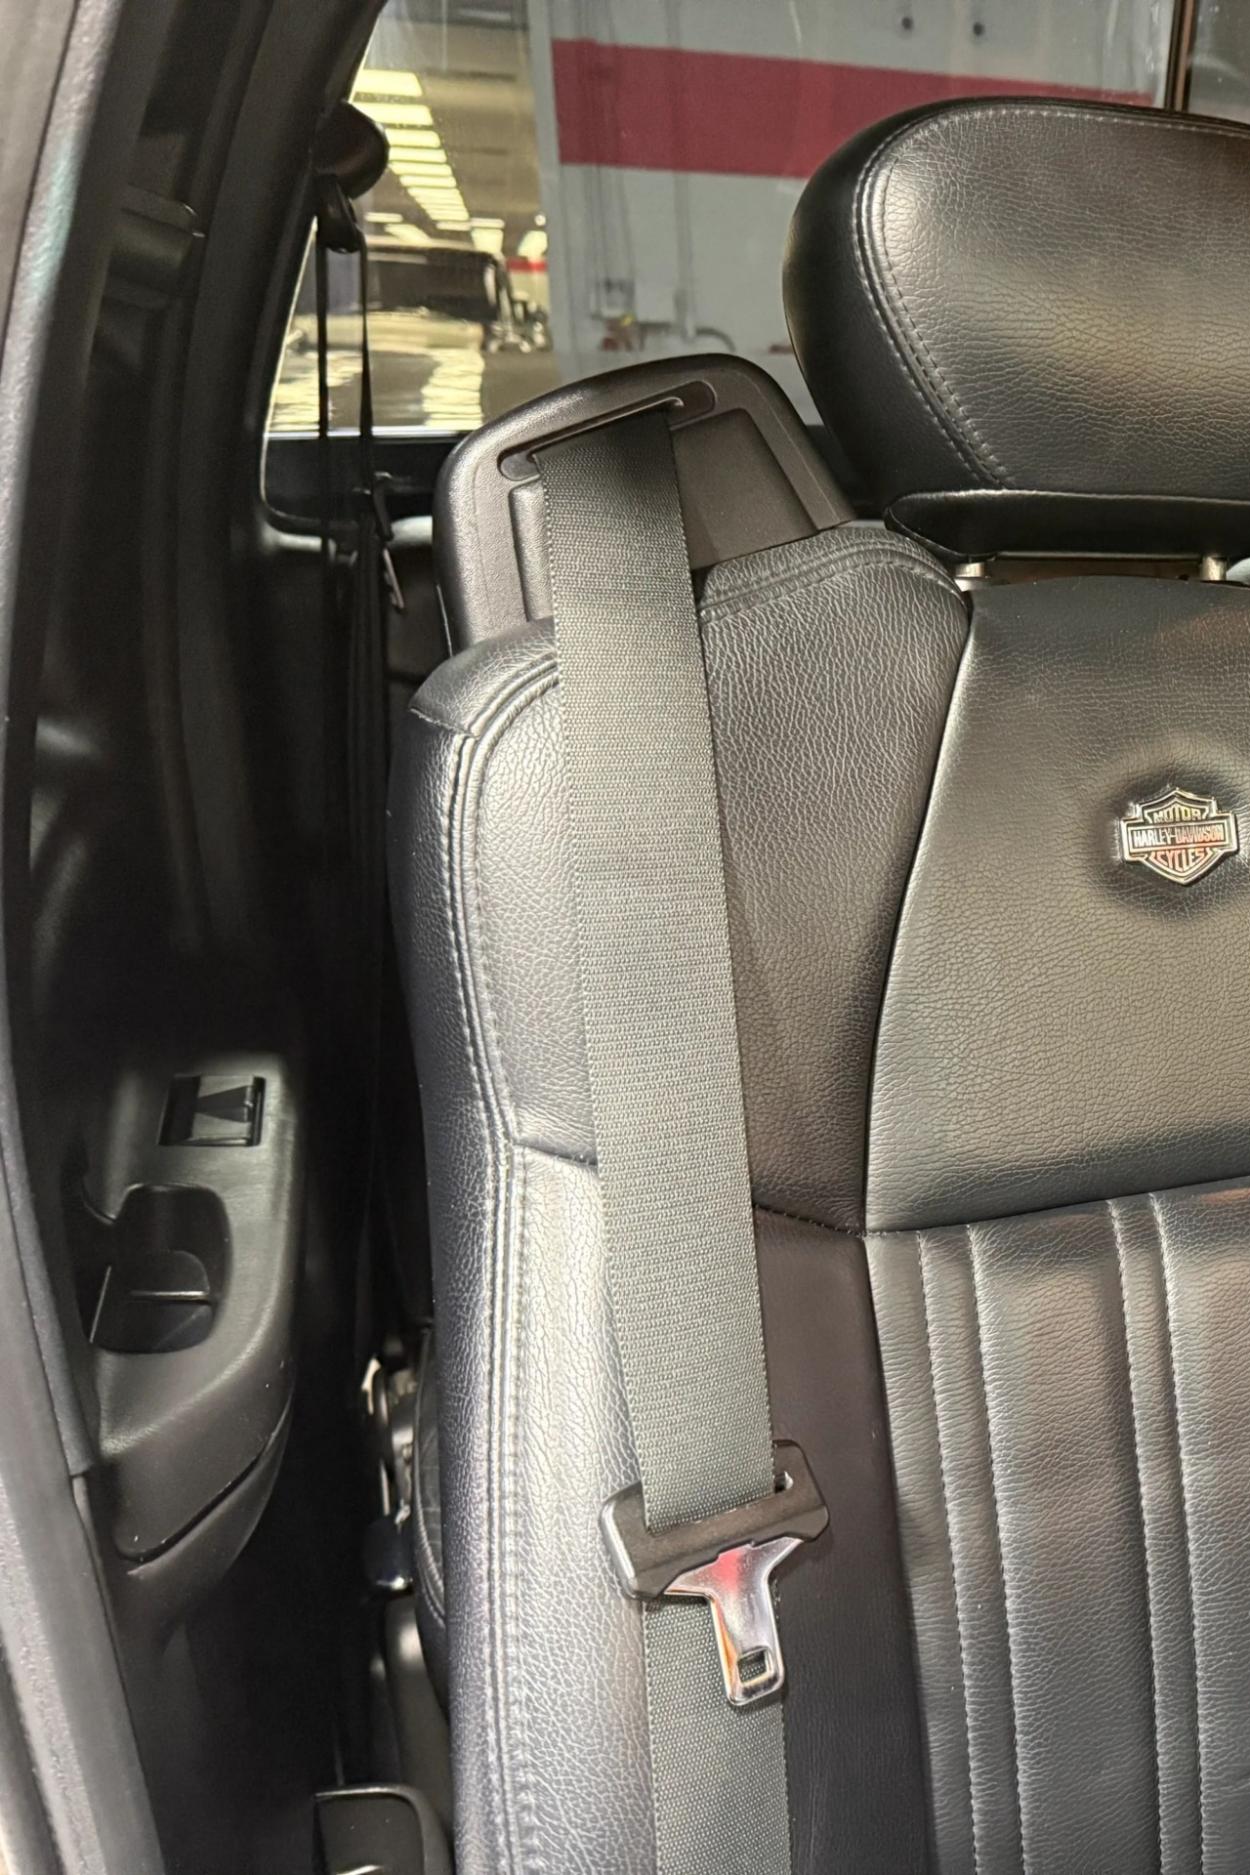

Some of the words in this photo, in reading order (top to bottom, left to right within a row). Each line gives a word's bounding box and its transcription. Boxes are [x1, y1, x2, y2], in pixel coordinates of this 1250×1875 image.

[1153, 803, 1201, 823] MOTOR
[1132, 824, 1225, 847] HARLEY-DAVIDSON
[1156, 847, 1205, 872] CYCLES
